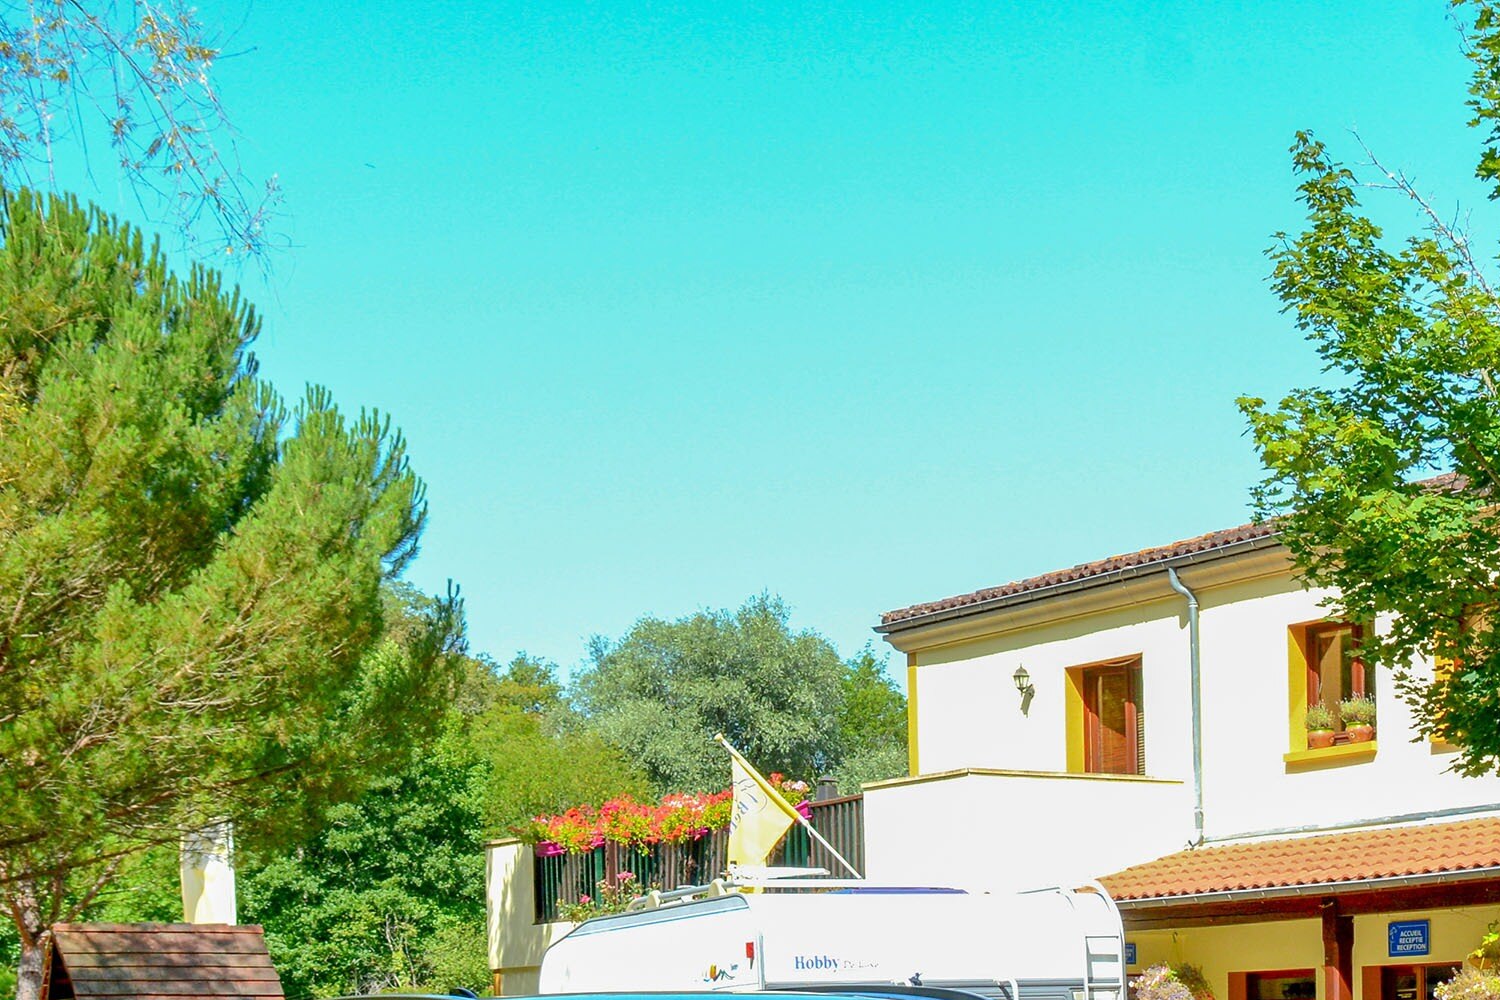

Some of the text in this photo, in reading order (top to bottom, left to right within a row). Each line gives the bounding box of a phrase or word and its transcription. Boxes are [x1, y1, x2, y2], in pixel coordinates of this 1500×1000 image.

[1399, 936, 1423, 944] RECEPTIE
[1396, 943, 1426, 951] RECEPTION
[795, 955, 839, 973] Hobby
